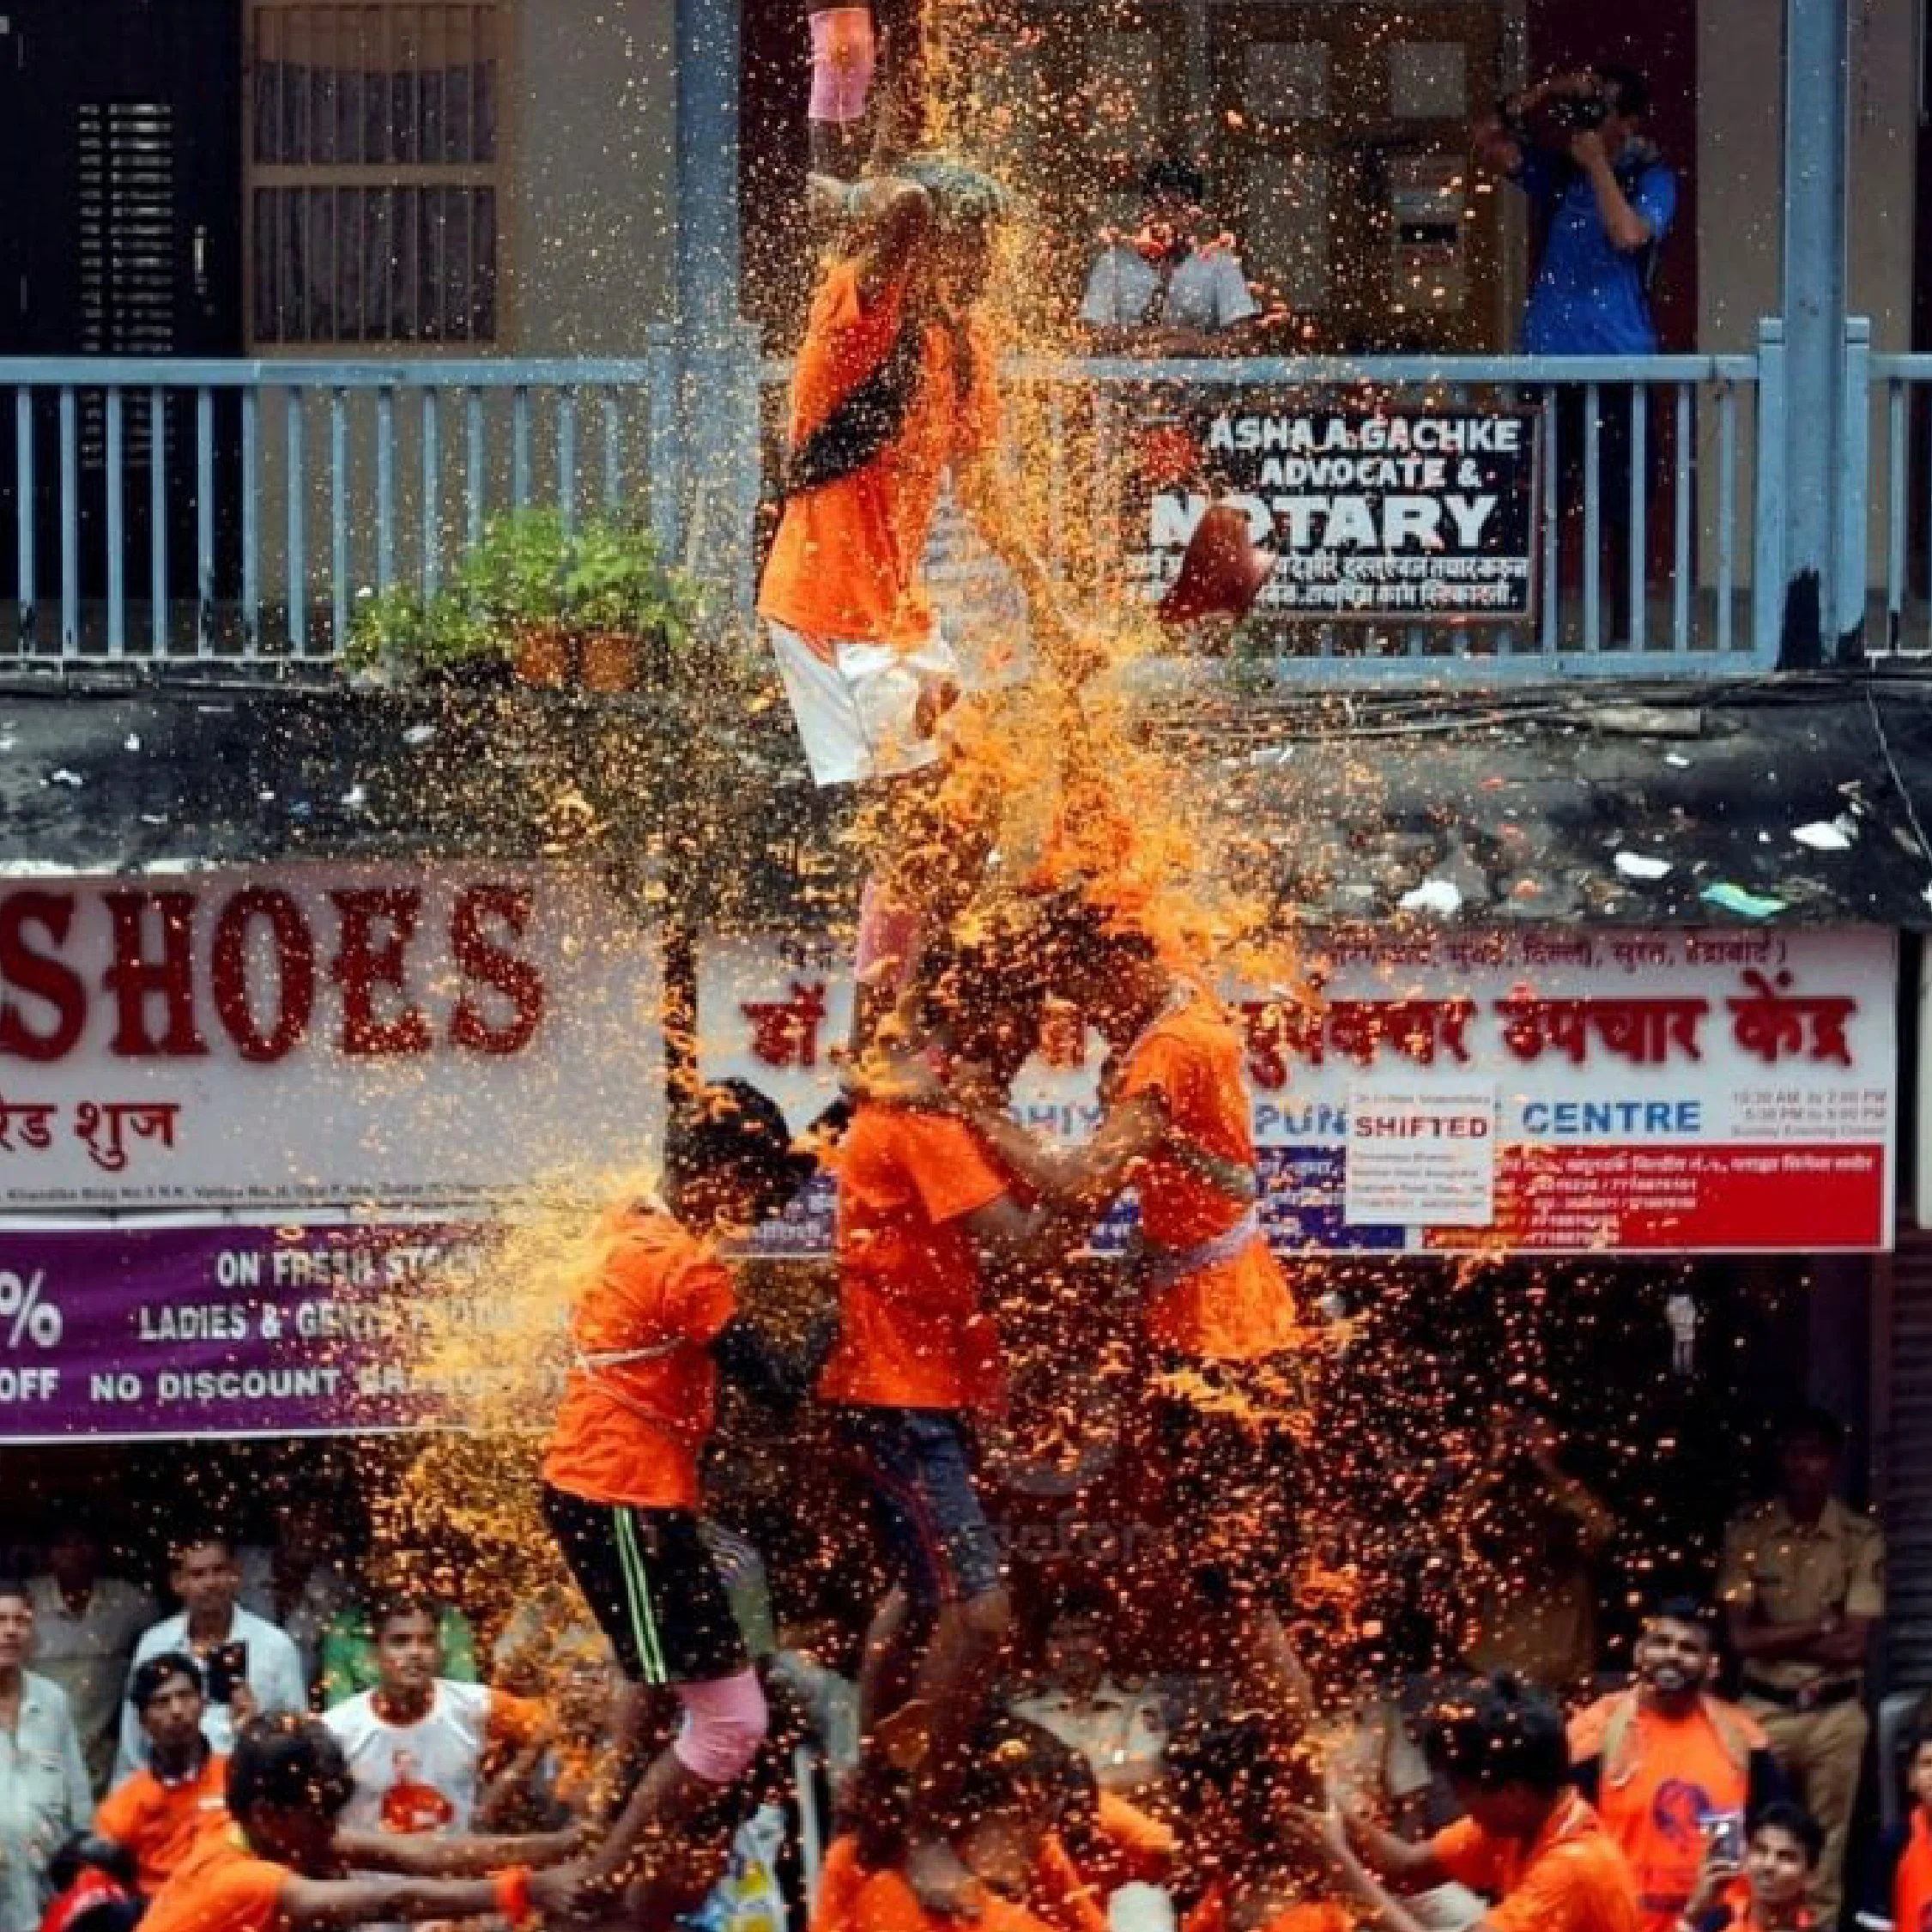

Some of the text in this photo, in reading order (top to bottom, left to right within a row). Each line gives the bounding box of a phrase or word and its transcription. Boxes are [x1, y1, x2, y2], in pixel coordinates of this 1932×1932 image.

[1210, 418, 1312, 451] ASHA
[1261, 457, 1483, 488] ADVOCATE &
[0, 887, 543, 1062] SHOES
[1493, 996, 1711, 1065] उपचार
[1726, 969, 1861, 1067] केंद्र
[1354, 1116, 1488, 1140] SHIFTED
[1523, 1099, 1701, 1134] CENTRE
[217, 1251, 259, 1287] ON
[138, 1304, 247, 1341] LADIES
[260, 1302, 282, 1339] &
[0, 1366, 61, 1404] OFF
[90, 1372, 142, 1402] NO
[158, 1368, 342, 1402] DISCOUNT
